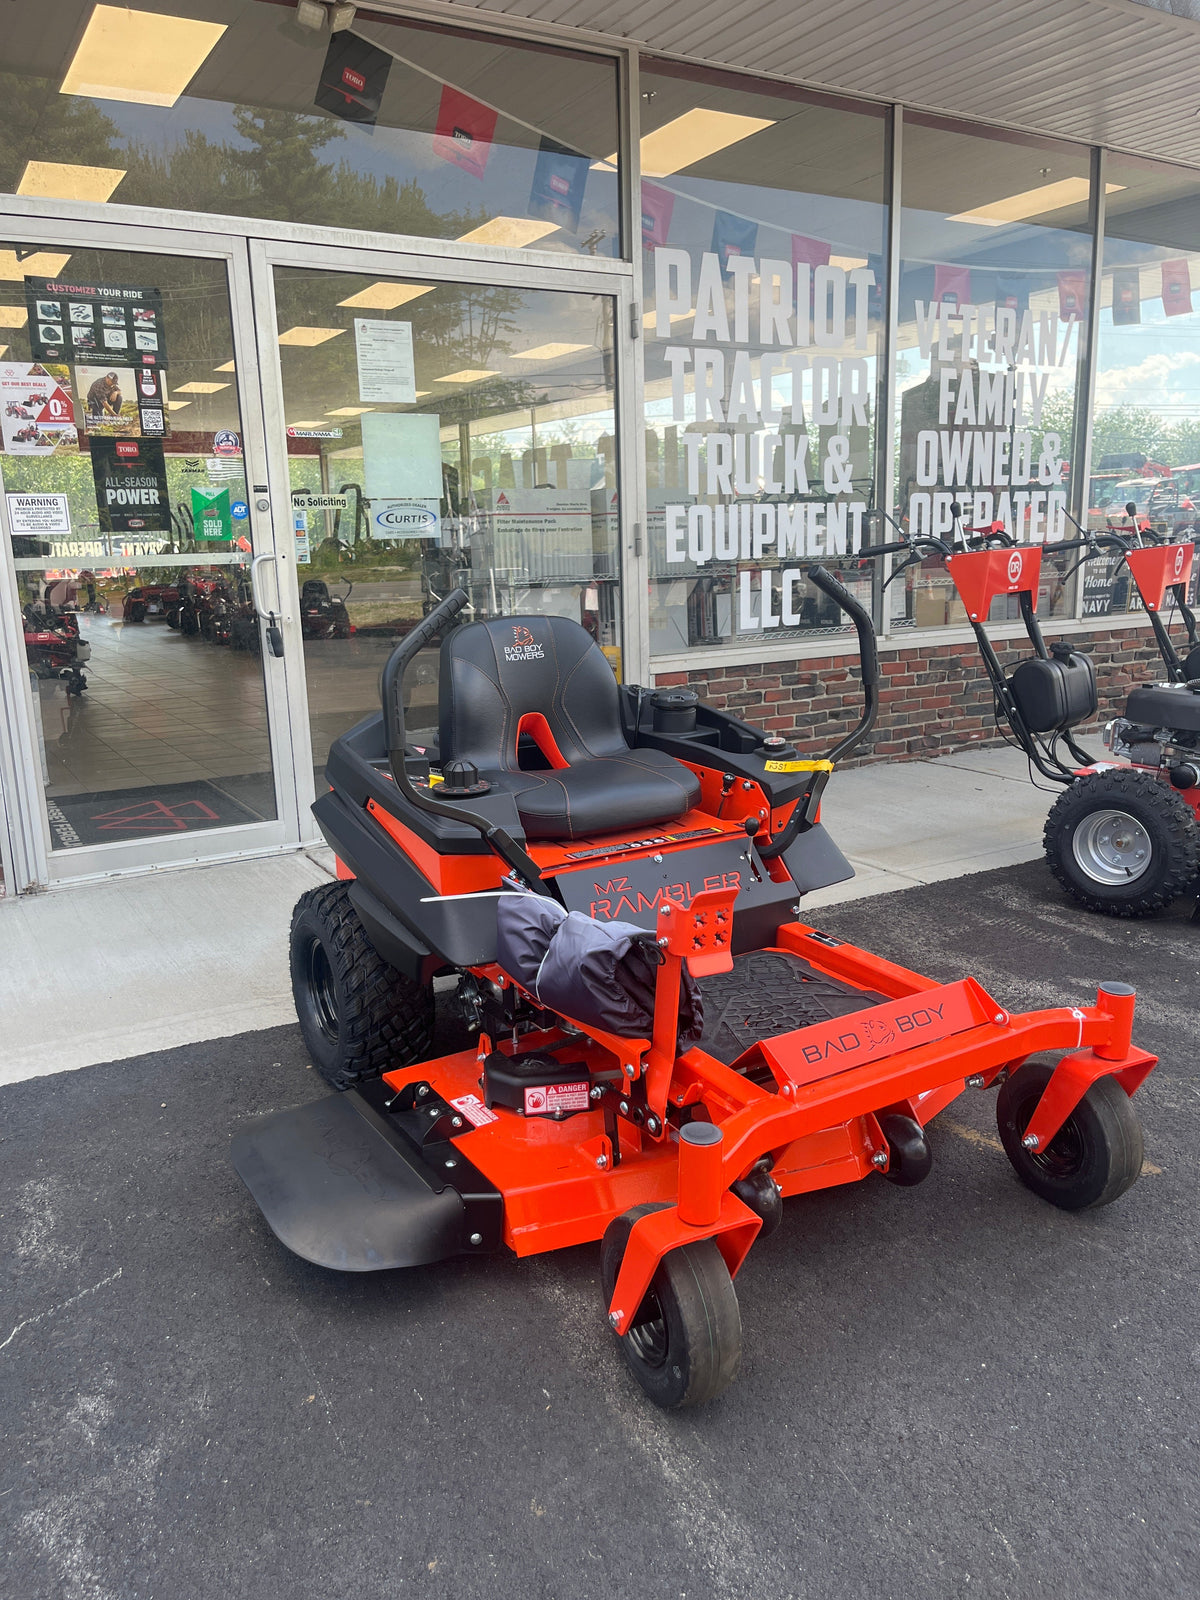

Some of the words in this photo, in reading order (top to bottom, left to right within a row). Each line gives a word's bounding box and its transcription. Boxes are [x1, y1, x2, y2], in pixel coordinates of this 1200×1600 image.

[345, 72, 363, 88] TORO
[454, 130, 472, 146] TORO
[46, 283, 96, 295] CUSTOMIZE
[97, 287, 121, 297] YOUR
[123, 290, 143, 299] RIDE
[654, 247, 875, 350] PATRIOT
[664, 347, 868, 426] TRACTOR
[939, 368, 1050, 426] FAMILY
[682, 433, 808, 495] TRUCK
[824, 435, 854, 494] &
[917, 430, 1032, 486] OWNED
[1039, 432, 1063, 485] &
[105, 477, 158, 488] ALL-SEASON
[106, 488, 160, 505] POWER
[294, 497, 304, 507] No
[307, 498, 346, 508] Soliciting
[203, 520, 222, 528] SOLD
[386, 513, 428, 524] CURTIS
[909, 491, 1067, 543] OPERATED
[204, 528, 222, 536] HERE
[666, 502, 867, 566] EQUIPMENT
[1010, 561, 1020, 573] DR
[1084, 575, 1112, 588] Home
[740, 568, 801, 630] LLC
[1082, 600, 1110, 613] NAVY
[504, 646, 522, 654] BAD
[524, 644, 543, 652] BOY
[505, 651, 544, 662] MOWERS
[594, 876, 632, 896] MZ
[590, 871, 742, 920] RAMBLER
[802, 1032, 861, 1065] BAD
[895, 1002, 944, 1034] BOY
[558, 1084, 587, 1093] DANGER
